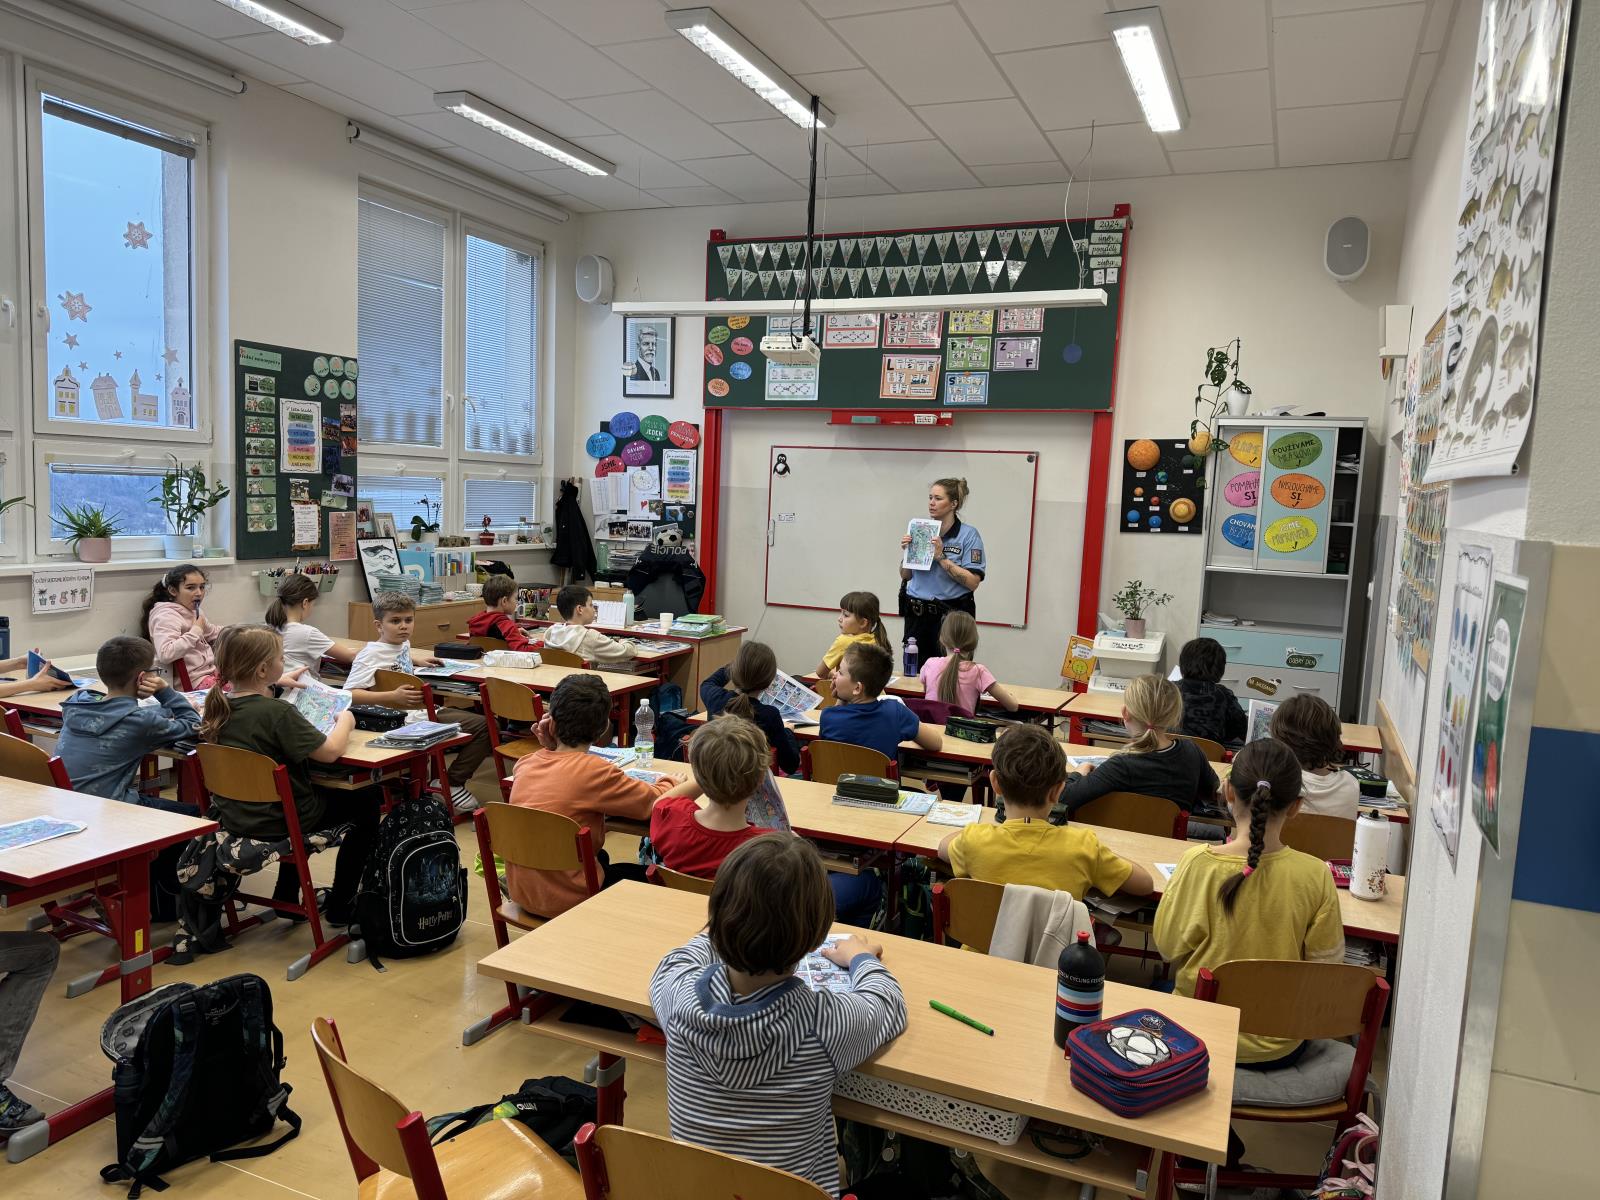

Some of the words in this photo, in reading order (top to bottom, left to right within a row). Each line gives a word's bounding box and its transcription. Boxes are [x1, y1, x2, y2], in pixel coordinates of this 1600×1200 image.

[999, 342, 1007, 351] Z
[886, 358, 894, 371] L
[1025, 358, 1034, 367] F
[948, 376, 956, 385] S
[650, 544, 688, 555] POLICIE
[417, 915, 438, 930] Harry
